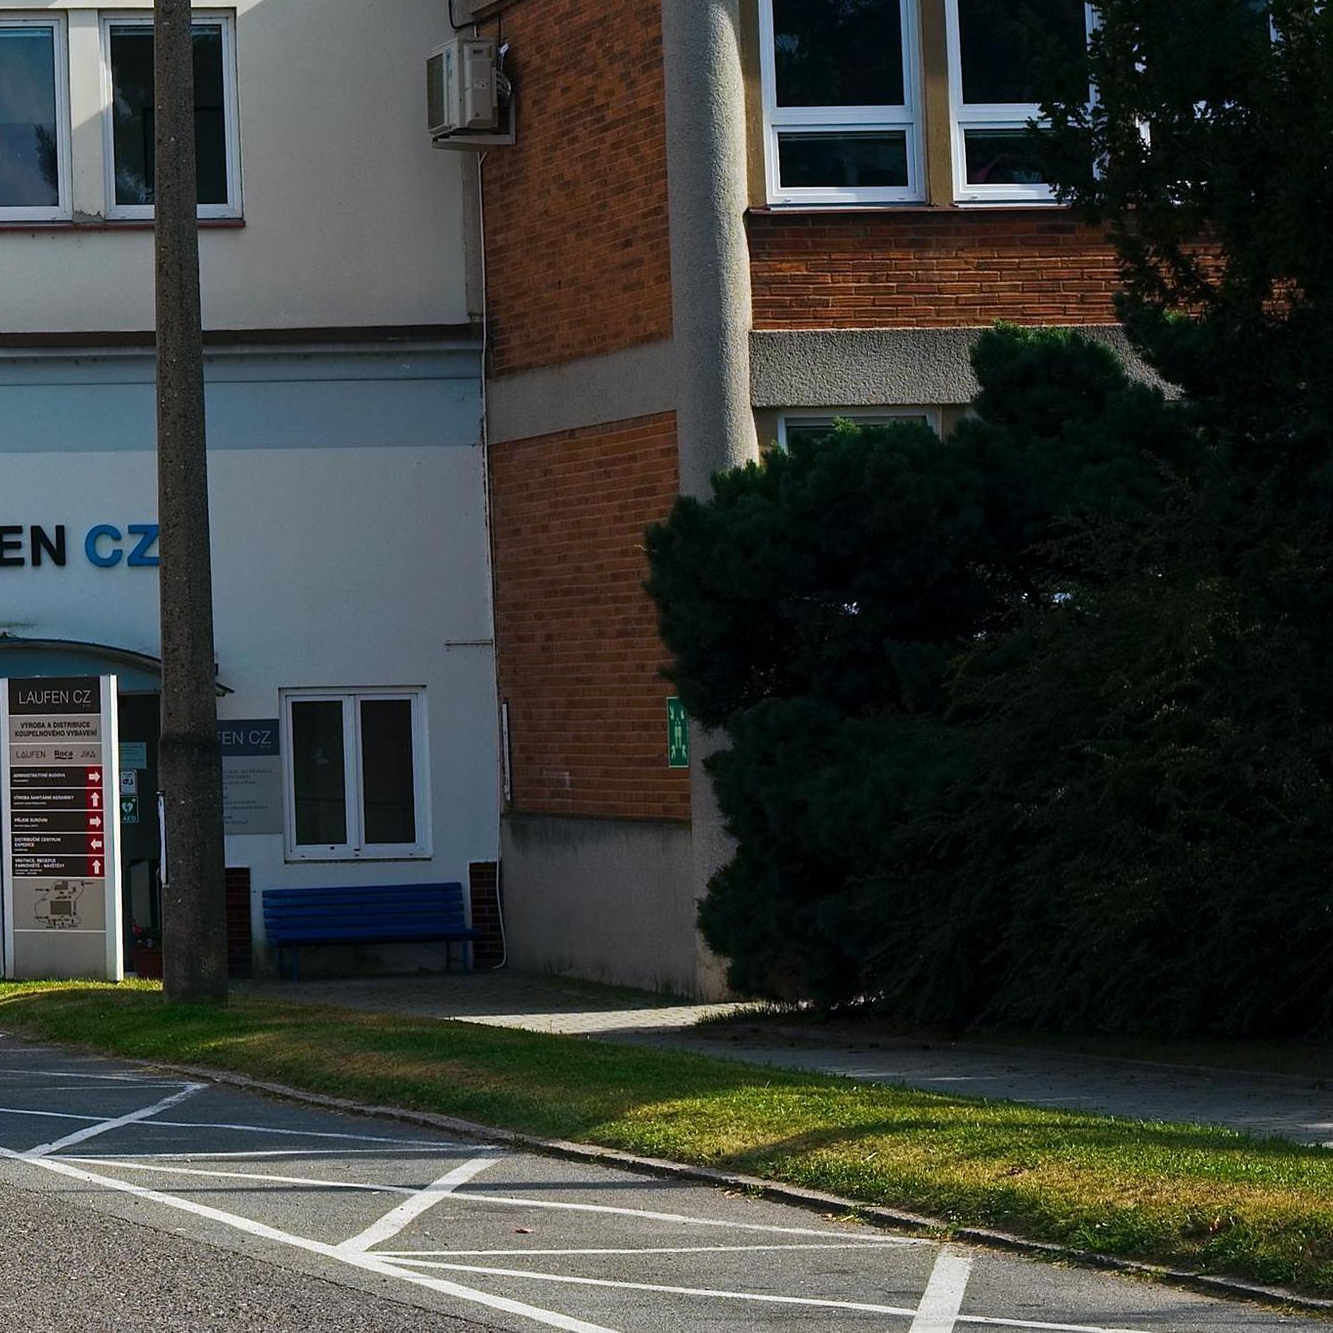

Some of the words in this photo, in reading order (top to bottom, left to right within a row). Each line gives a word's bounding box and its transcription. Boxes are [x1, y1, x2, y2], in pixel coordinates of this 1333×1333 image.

[84, 524, 160, 568] CZ
[19, 691, 69, 704] LAUFEN
[73, 690, 92, 704] CZ
[249, 730, 272, 745] CZ
[16, 750, 46, 758] LAUFEN
